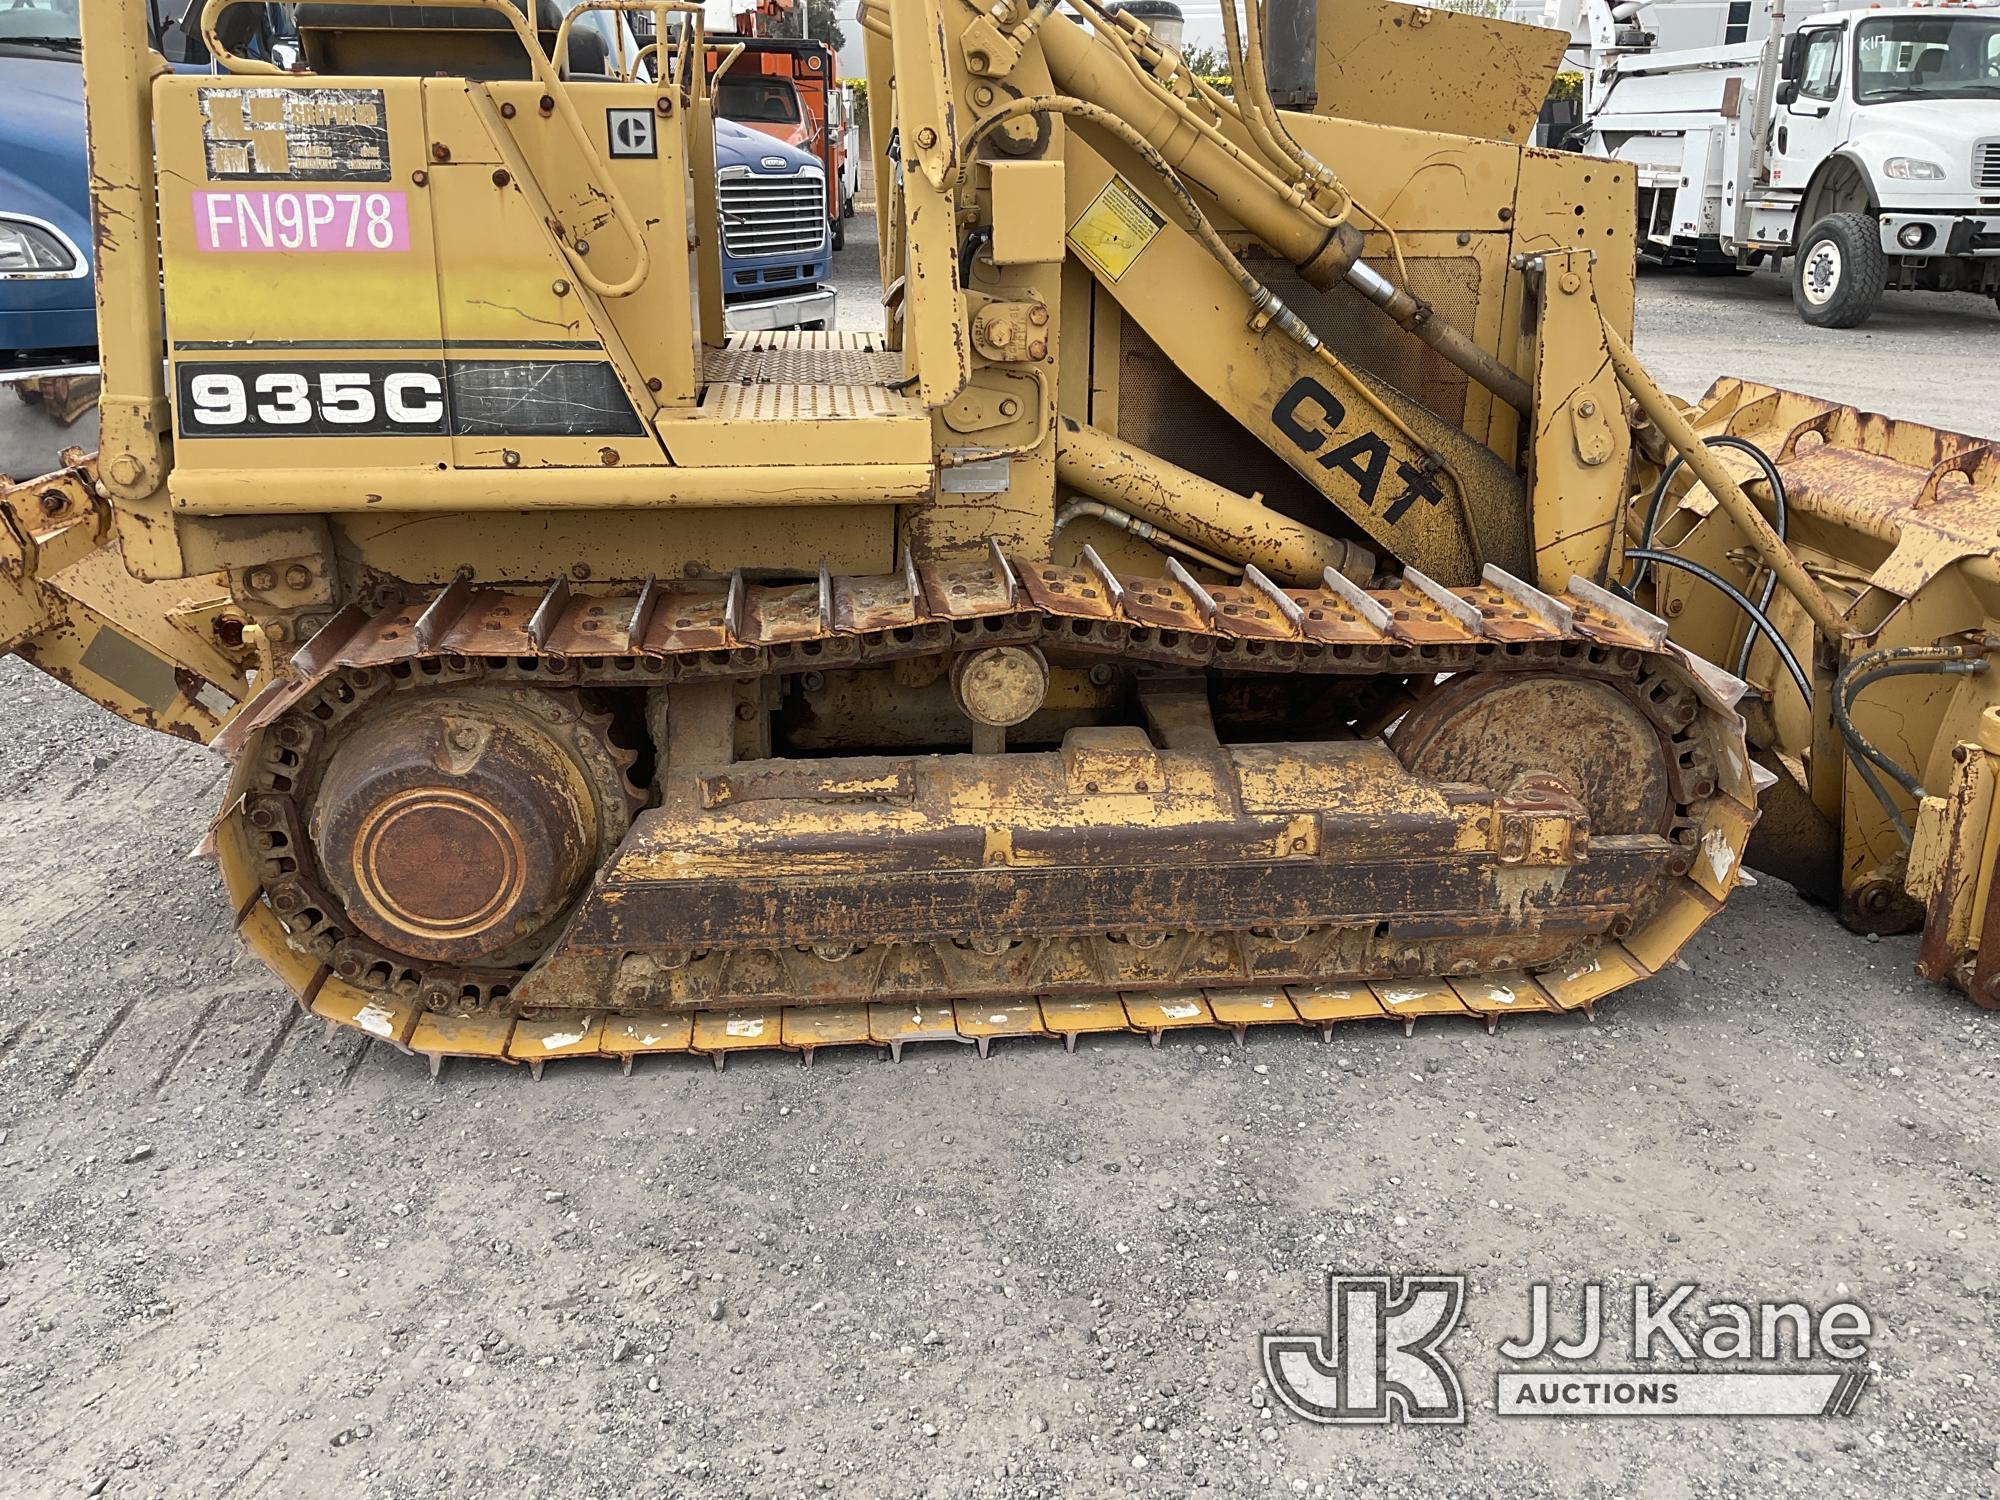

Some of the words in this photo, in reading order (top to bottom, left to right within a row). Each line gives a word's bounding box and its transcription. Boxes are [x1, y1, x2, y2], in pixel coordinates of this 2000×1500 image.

[206, 193, 394, 249] FN9P78
[1129, 193, 1154, 218] WARNING
[191, 372, 444, 425] 935C
[1271, 376, 1445, 526] CAT
